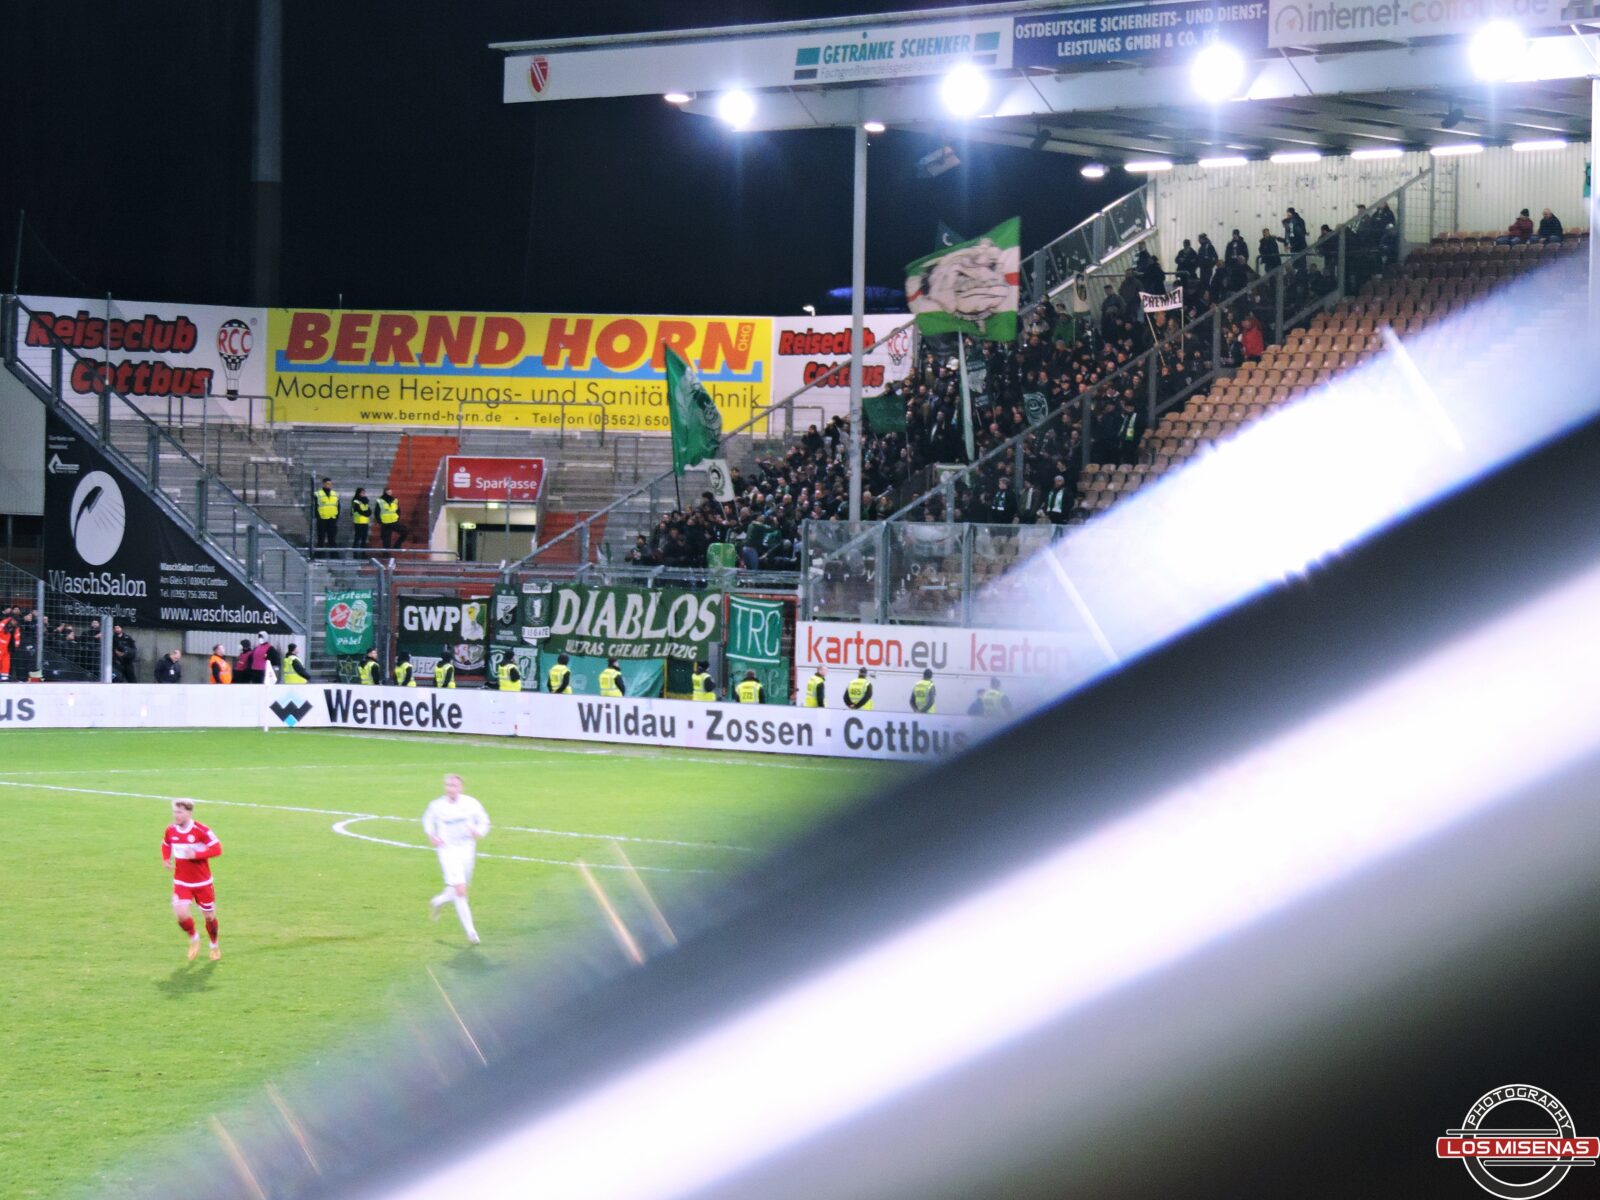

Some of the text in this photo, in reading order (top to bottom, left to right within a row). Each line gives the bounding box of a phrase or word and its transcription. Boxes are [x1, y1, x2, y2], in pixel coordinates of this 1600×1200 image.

[1015, 4, 1268, 40] OSTDEUTSCHE SICHERHEITS- UND DIENST-
[823, 32, 971, 65] GETRÄNKE SCHENKER
[1057, 37, 1122, 57] LEISTUNGS
[1125, 34, 1161, 50] GMBH
[1164, 33, 1173, 48] &
[1177, 31, 1197, 46] CO.
[25, 310, 198, 354] Reiseclub
[218, 328, 252, 354] RCC
[285, 312, 756, 371] BERND HORN
[737, 324, 752, 352] OHG
[778, 328, 876, 356] Reiseclb
[71, 357, 214, 397] Cottbus
[275, 376, 390, 401] Moderne
[400, 378, 523, 409] Heizungs-
[531, 381, 577, 406] und
[360, 409, 503, 423] www.bernd-horn.de
[533, 413, 585, 426] Telefon
[588, 413, 641, 427] (03562)
[476, 477, 538, 492] Sparkasse
[48, 570, 148, 598] WaschSalon
[160, 604, 278, 625] www.waschsalon.eu
[403, 605, 461, 632] GWP
[550, 588, 721, 642] DIABLOS
[807, 625, 948, 669] karton.eu
[323, 689, 463, 729] Wernecke
[577, 703, 968, 757] Wildau Zossen Cottbus
